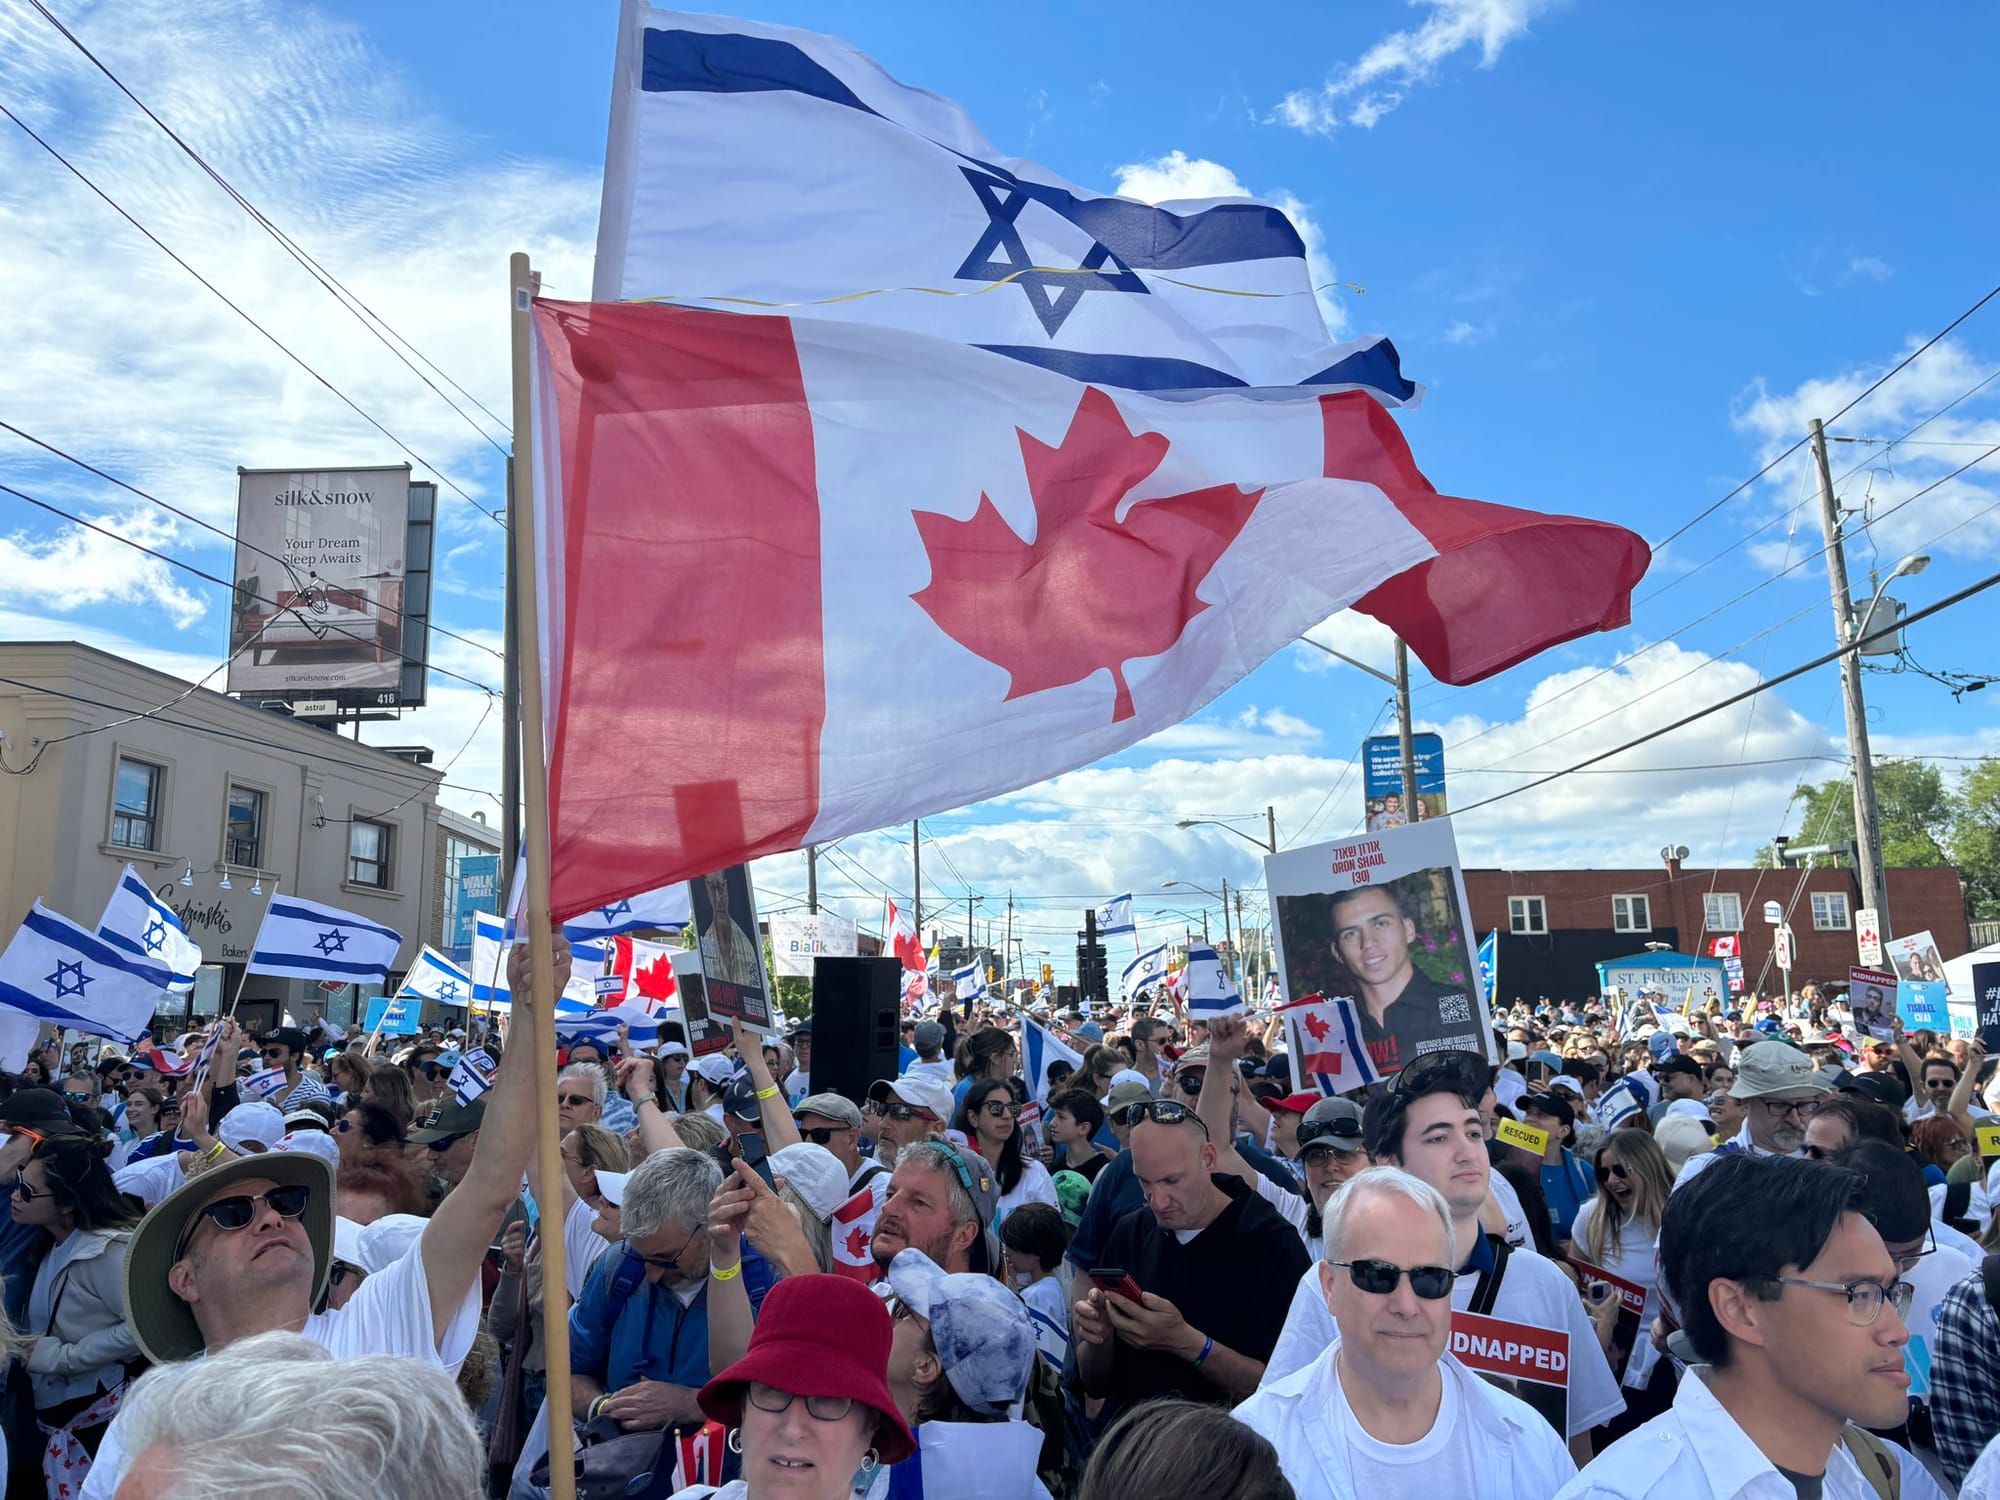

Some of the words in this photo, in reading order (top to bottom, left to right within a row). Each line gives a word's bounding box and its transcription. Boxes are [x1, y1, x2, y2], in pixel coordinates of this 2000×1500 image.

[274, 489, 375, 507] silk&snow
[285, 538, 315, 549] Your
[318, 537, 360, 549] Dream
[282, 553, 316, 567] Sleep
[319, 552, 361, 564] Awaits
[377, 693, 395, 705] 418
[304, 703, 326, 711] astral
[1332, 858, 1356, 875] ORON
[1357, 853, 1388, 870] SHAUL
[462, 874, 494, 890] WALK
[1351, 869, 1371, 885] (30)
[467, 887, 494, 899] ISRAEL
[221, 943, 248, 958] Bakers
[790, 939, 828, 953] Bialik
[1618, 973, 1638, 985] ST.
[1643, 971, 1712, 985] EUGENE'S
[1852, 971, 1897, 986] KIDNAPPED
[689, 1017, 709, 1032] BRING
[691, 1030, 705, 1041] HIM
[1503, 1125, 1541, 1145] RESCUED
[1448, 1330, 1566, 1372] IDNAPPED
